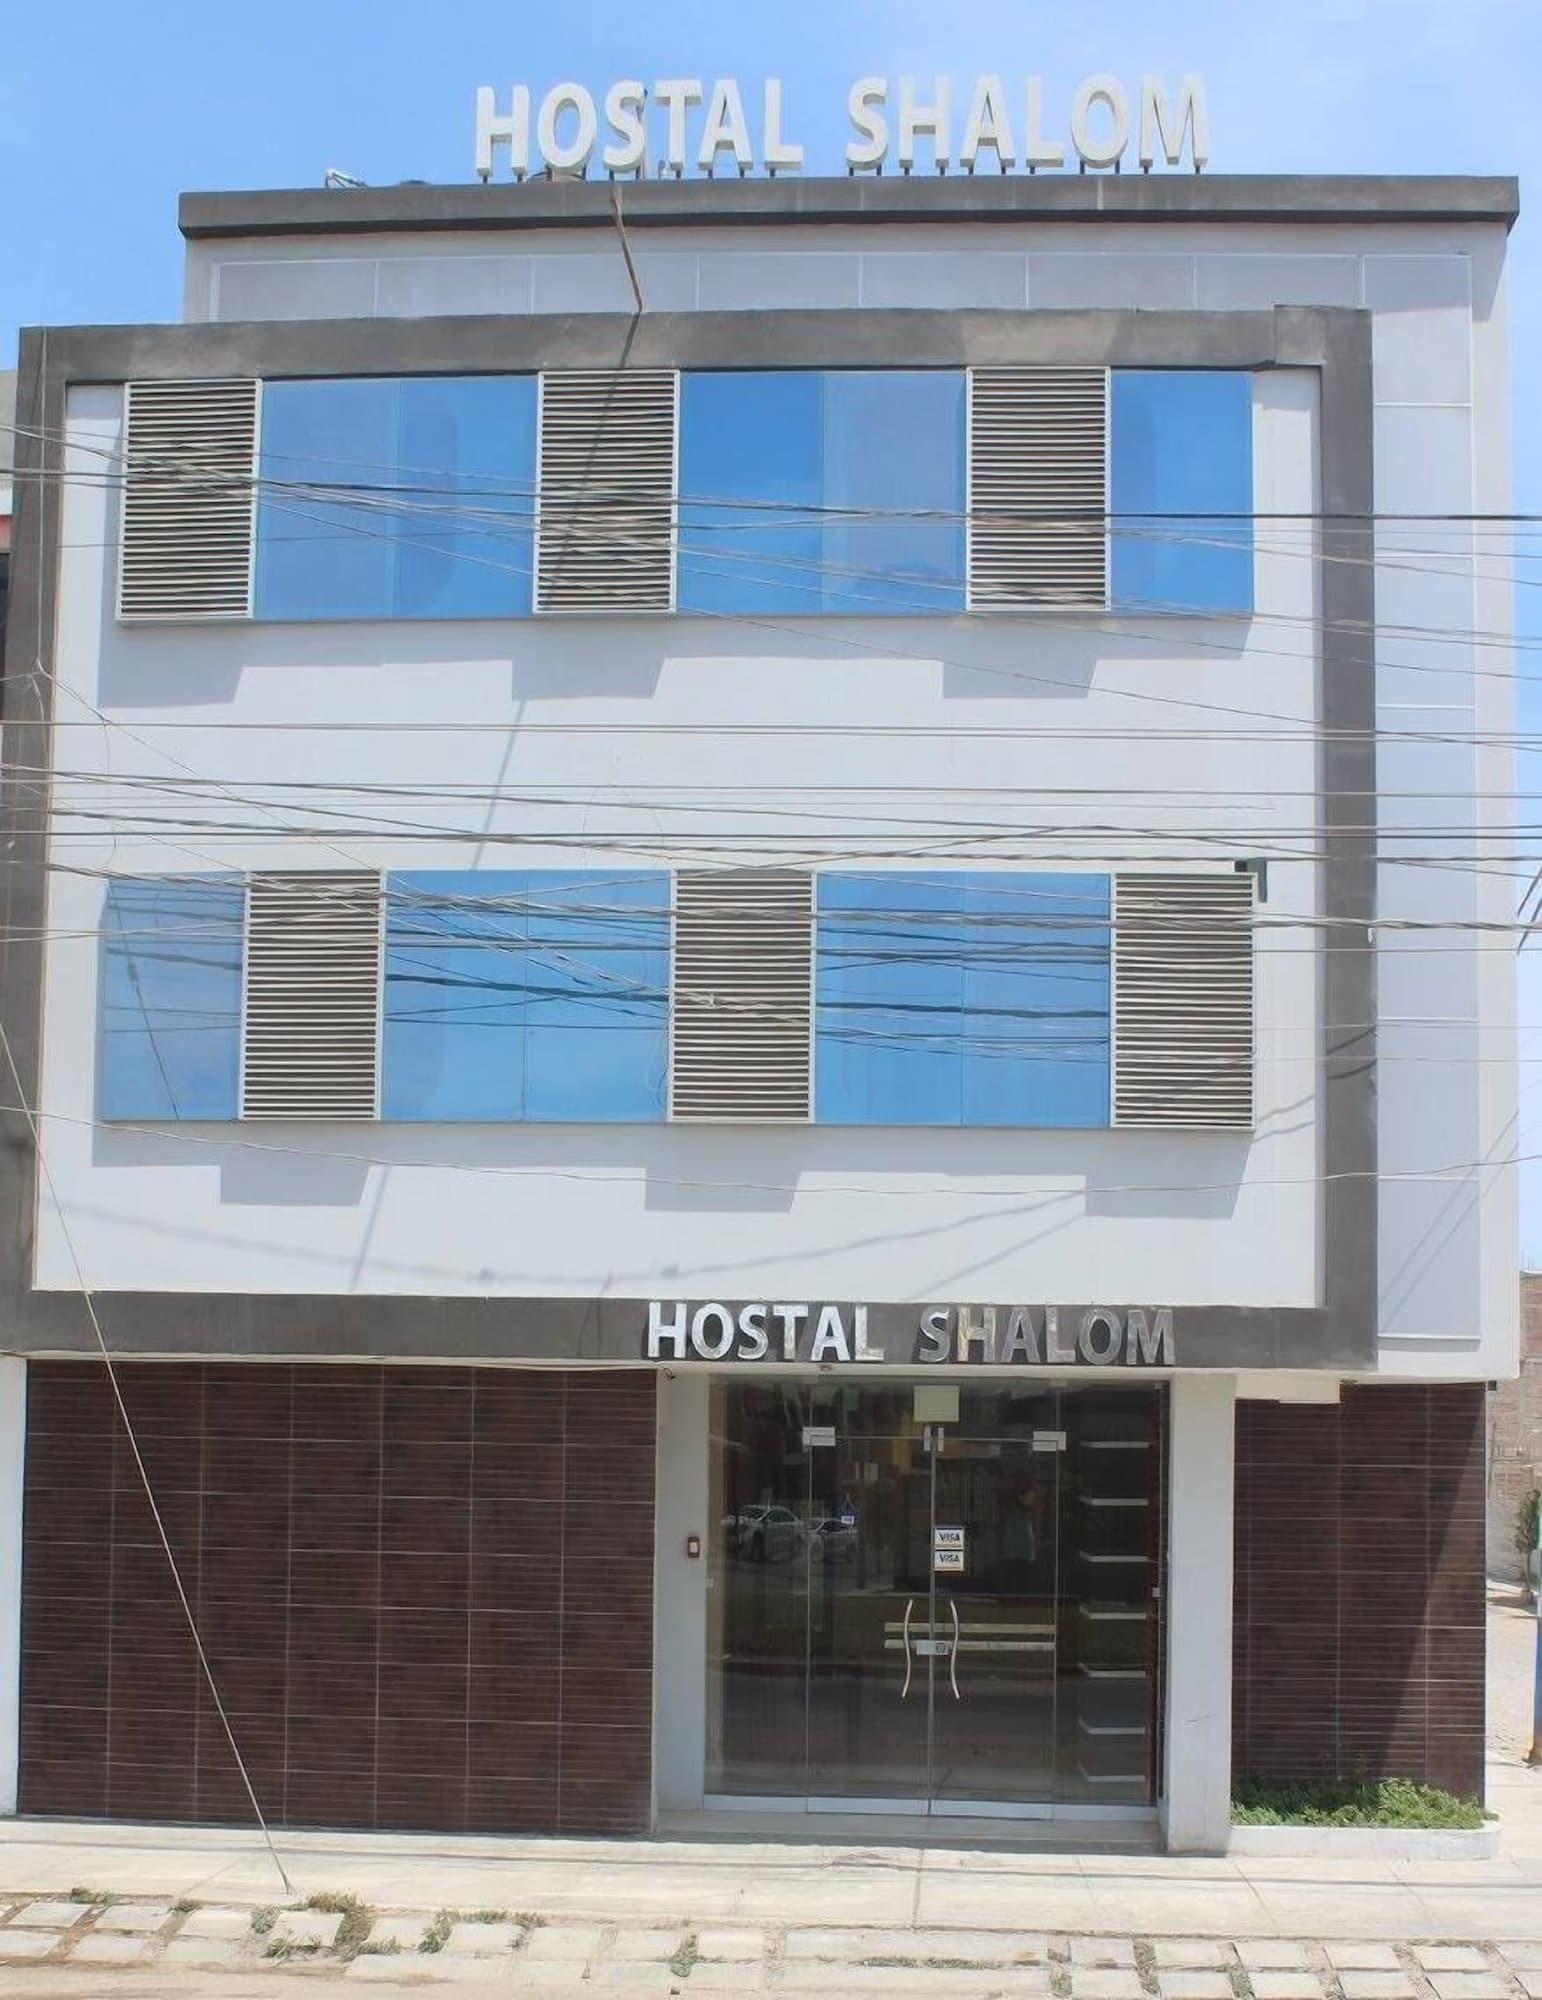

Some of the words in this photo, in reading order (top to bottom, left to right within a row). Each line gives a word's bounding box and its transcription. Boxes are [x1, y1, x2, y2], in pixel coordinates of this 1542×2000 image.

[475, 78, 804, 176] HOSTAL
[845, 73, 1207, 170] SHALOM
[647, 1301, 886, 1361] HOSTAL
[918, 1305, 1176, 1366] SHALOM
[939, 1532, 960, 1542] VISA
[939, 1553, 960, 1562] VISA
